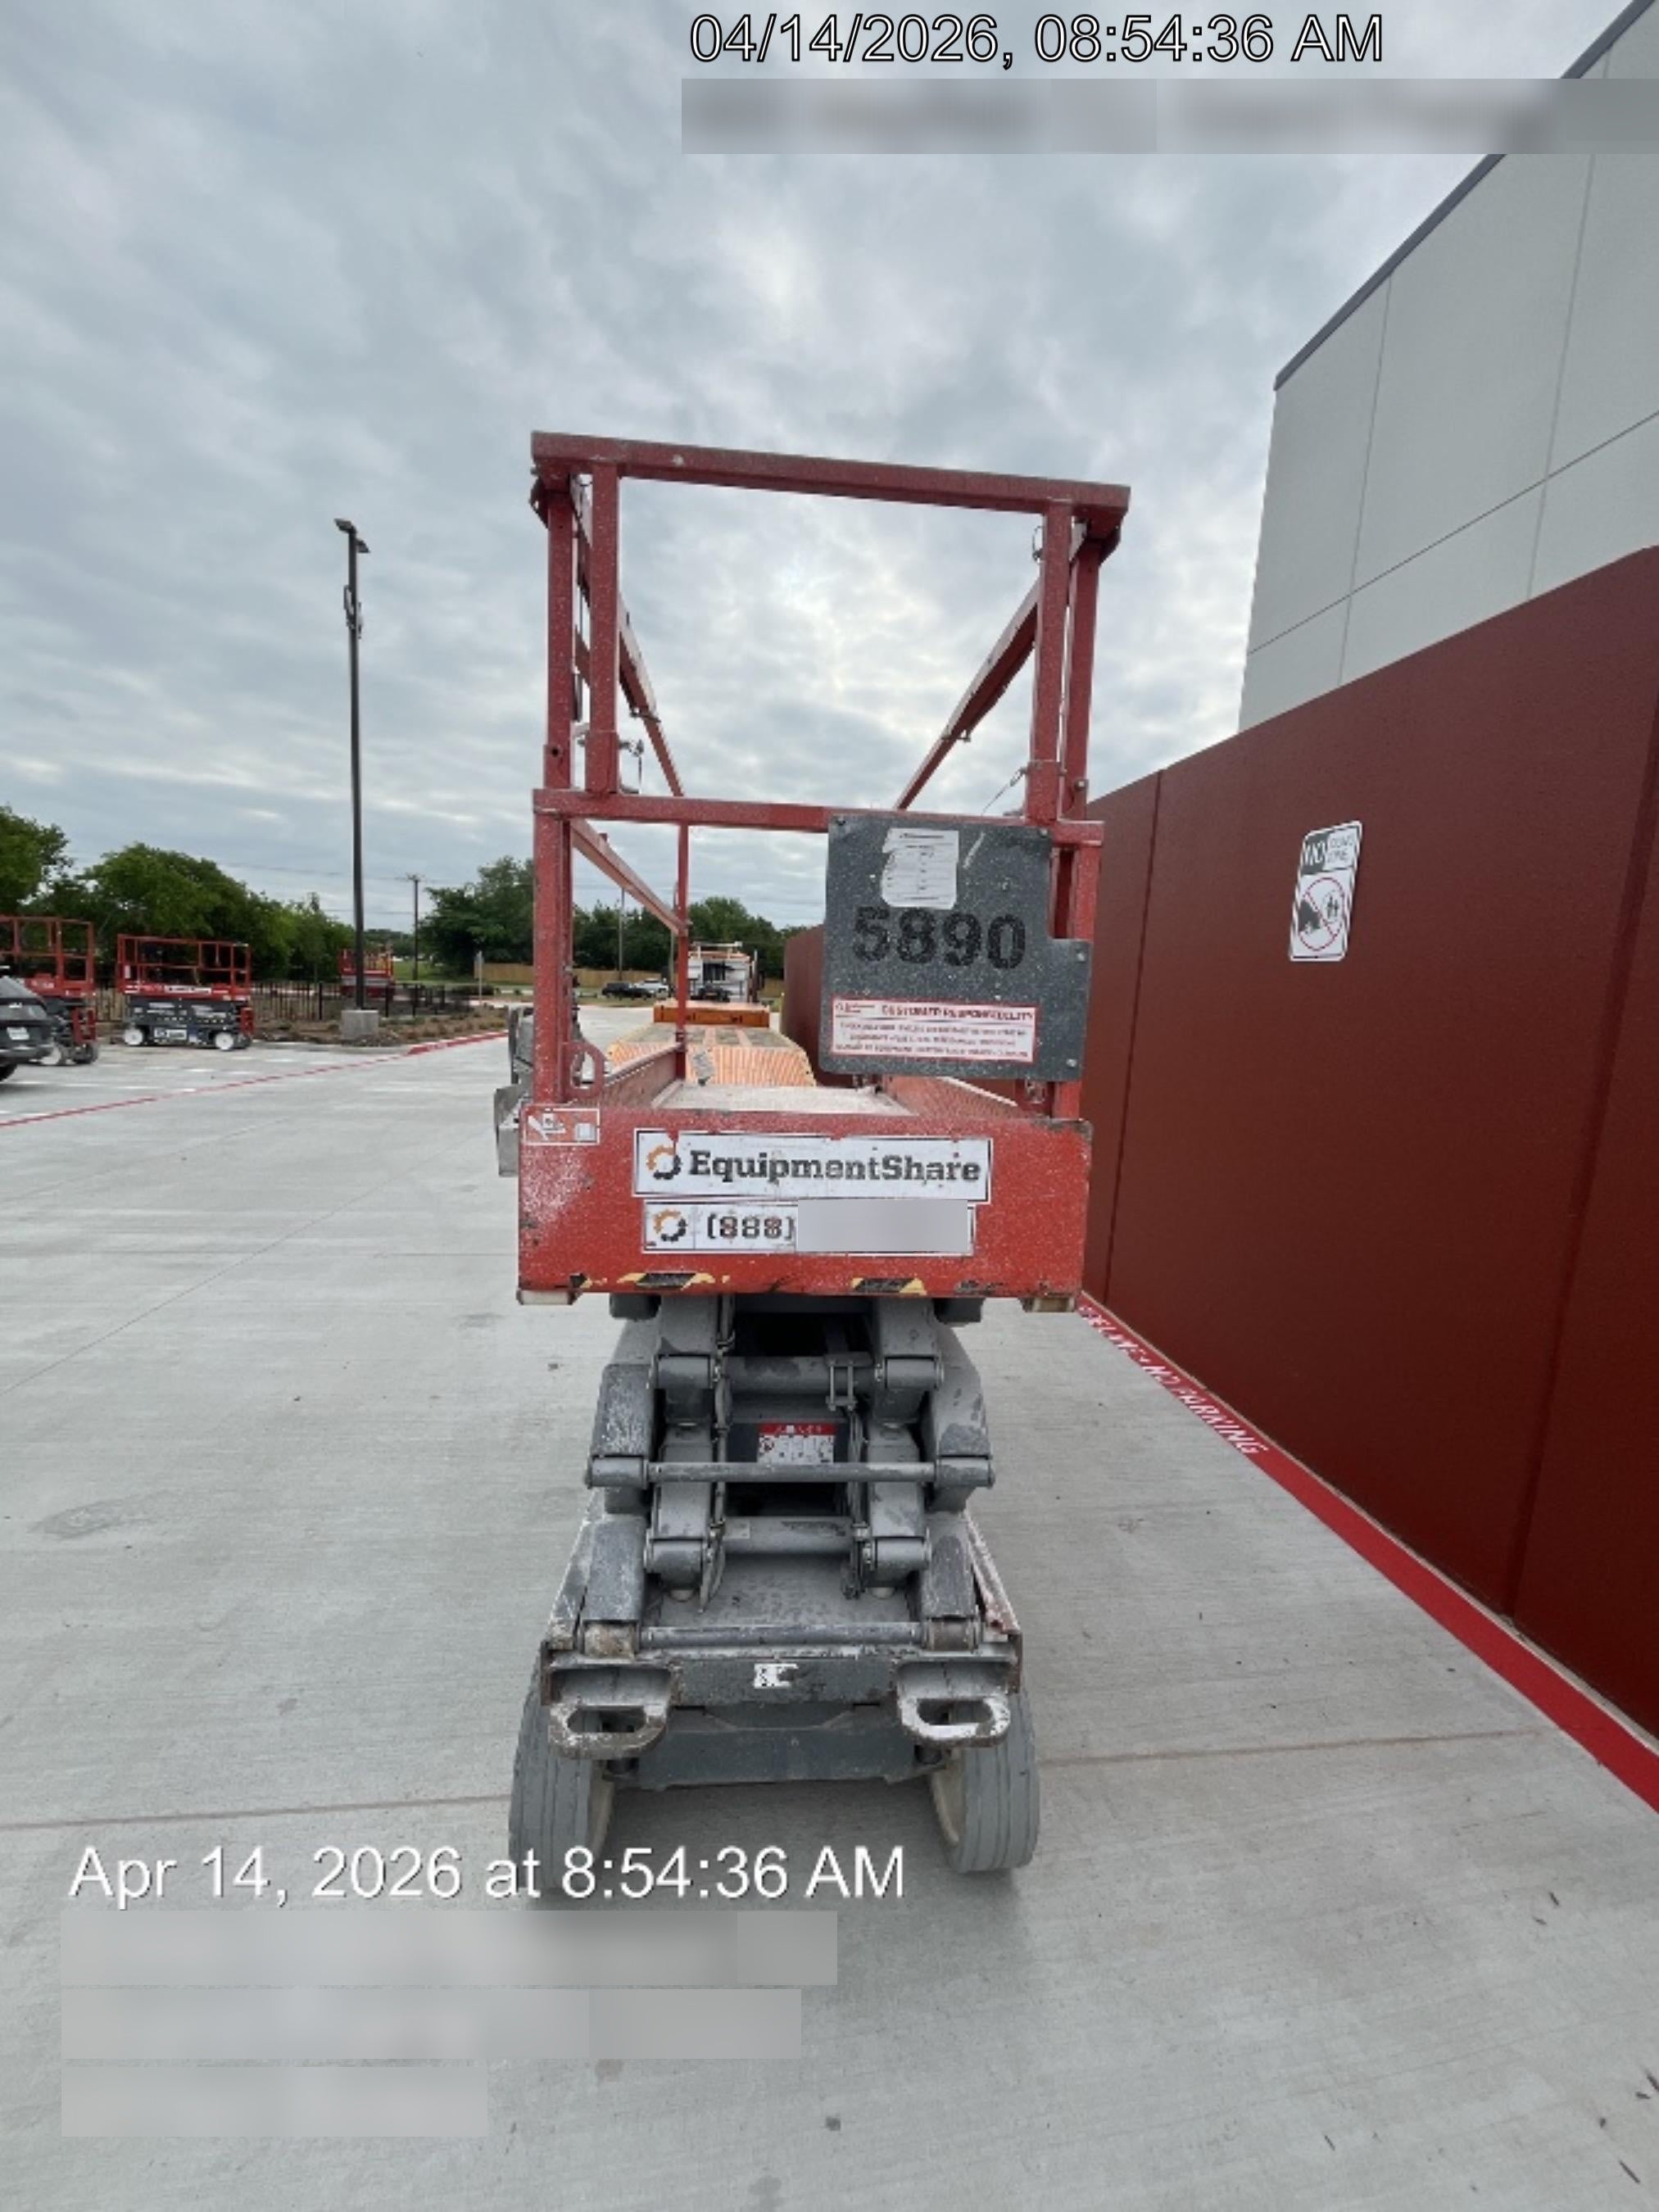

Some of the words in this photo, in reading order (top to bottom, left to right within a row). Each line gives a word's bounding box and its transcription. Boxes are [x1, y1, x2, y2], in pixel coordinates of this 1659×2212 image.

[853, 905, 1026, 970] 5890
[690, 1149, 981, 1186] EquipmentShare
[707, 1213, 796, 1240] (888)
